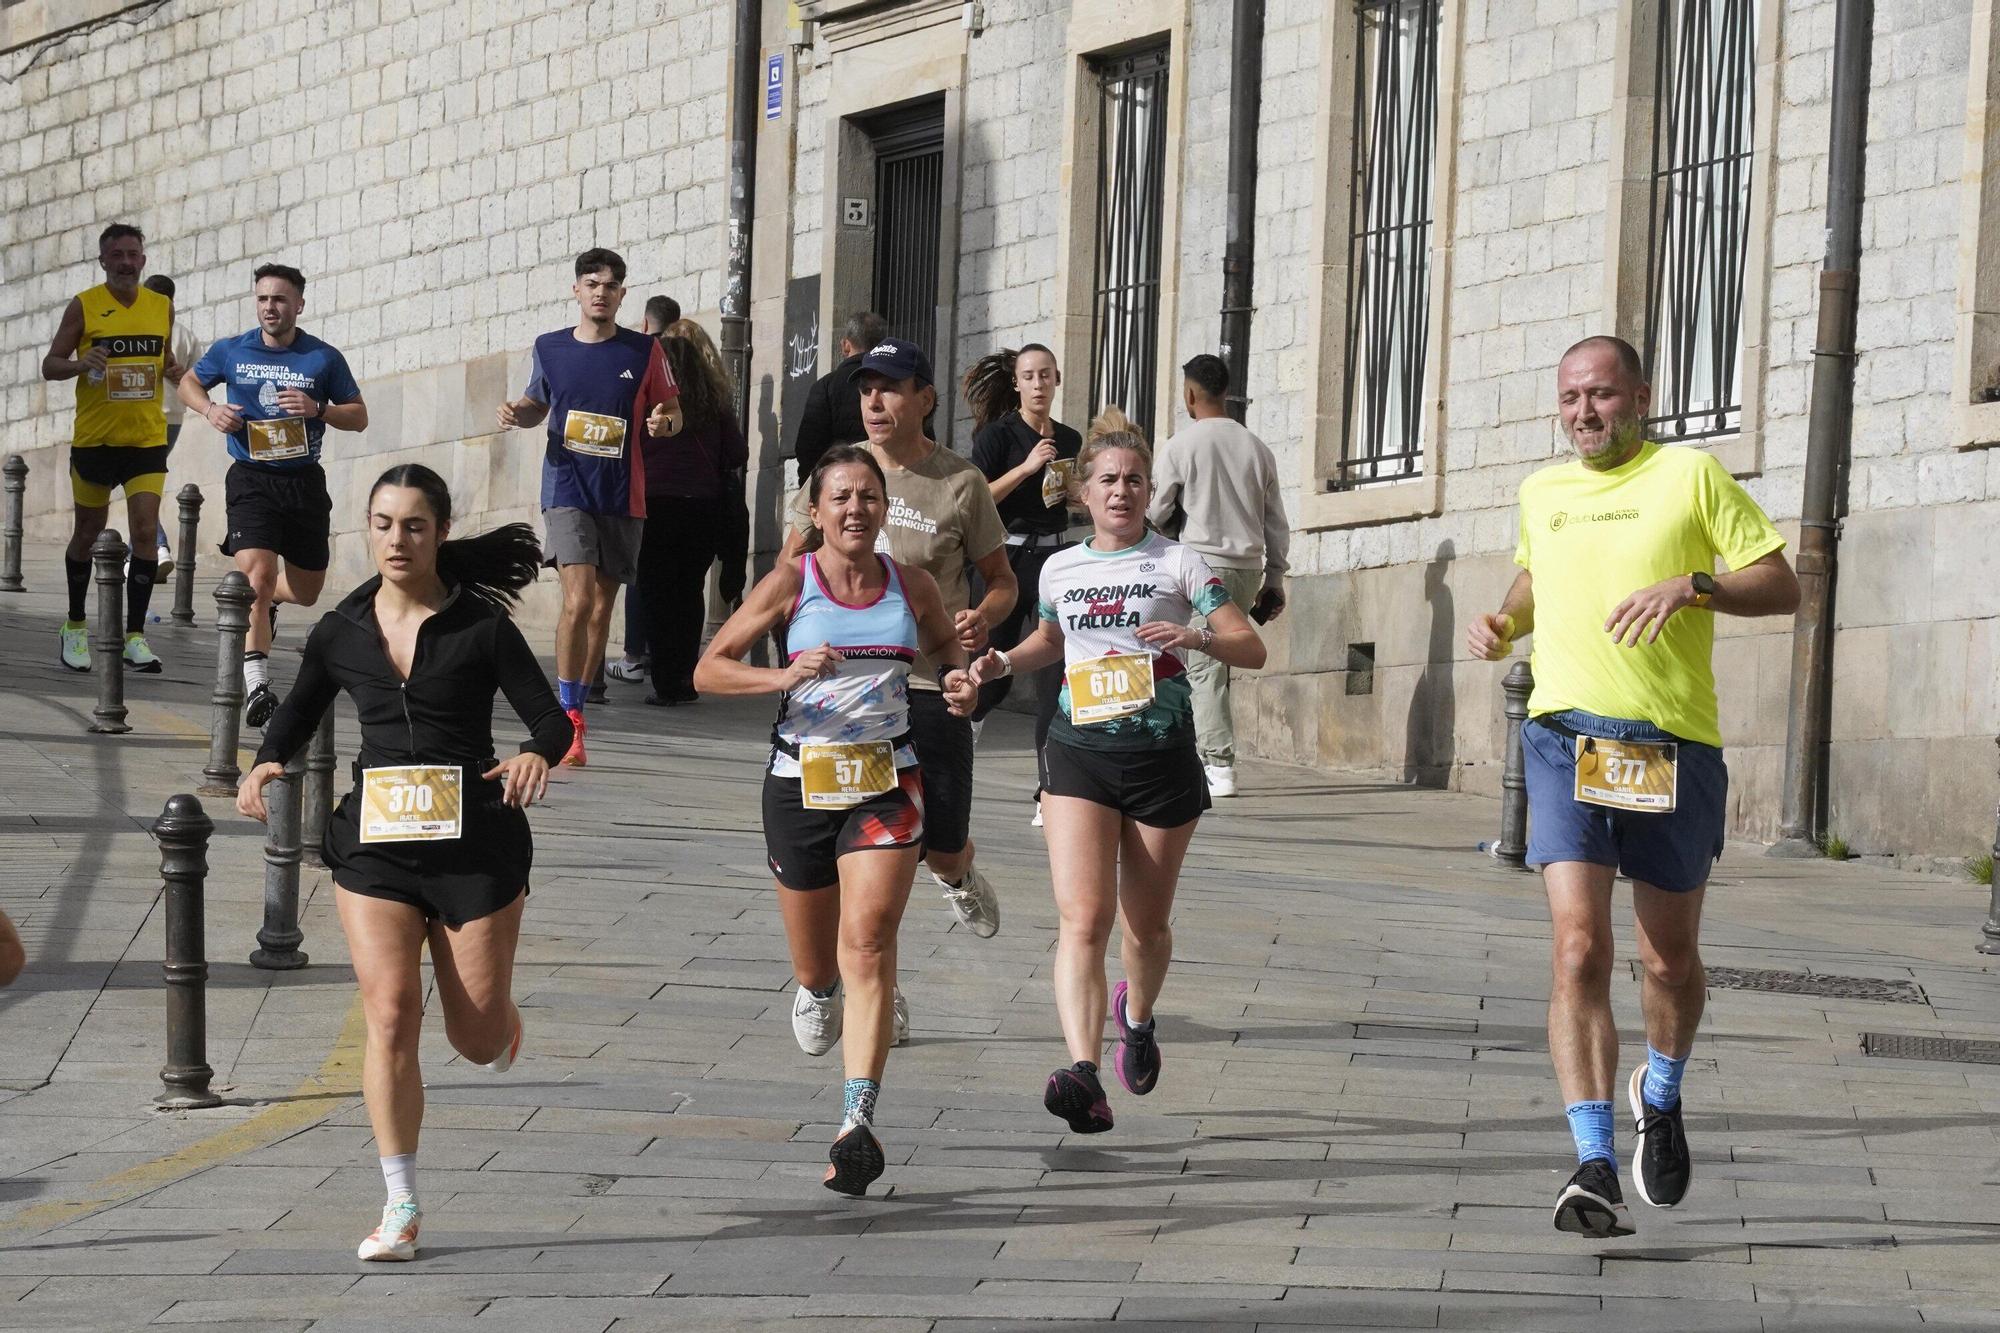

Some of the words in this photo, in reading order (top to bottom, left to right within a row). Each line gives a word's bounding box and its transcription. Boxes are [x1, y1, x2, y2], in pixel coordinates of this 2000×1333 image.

[113, 340, 158, 353] OINT
[245, 363, 290, 373] CONQUISTA
[246, 370, 304, 382] ALMENDRA
[121, 372, 146, 388] 576
[277, 379, 314, 389] KONKISTA
[267, 428, 288, 445] 54
[583, 423, 608, 442] 217
[888, 516, 938, 535] KONKISTA
[1591, 511, 1640, 522] LaBlanca
[1063, 583, 1157, 604] SORGINAK
[1066, 611, 1140, 631] TALDEA
[838, 646, 897, 657] OTIVACIÓN
[1089, 669, 1129, 698] 670
[835, 759, 863, 785] 57
[1605, 757, 1647, 785] 377
[388, 784, 433, 813] 370
